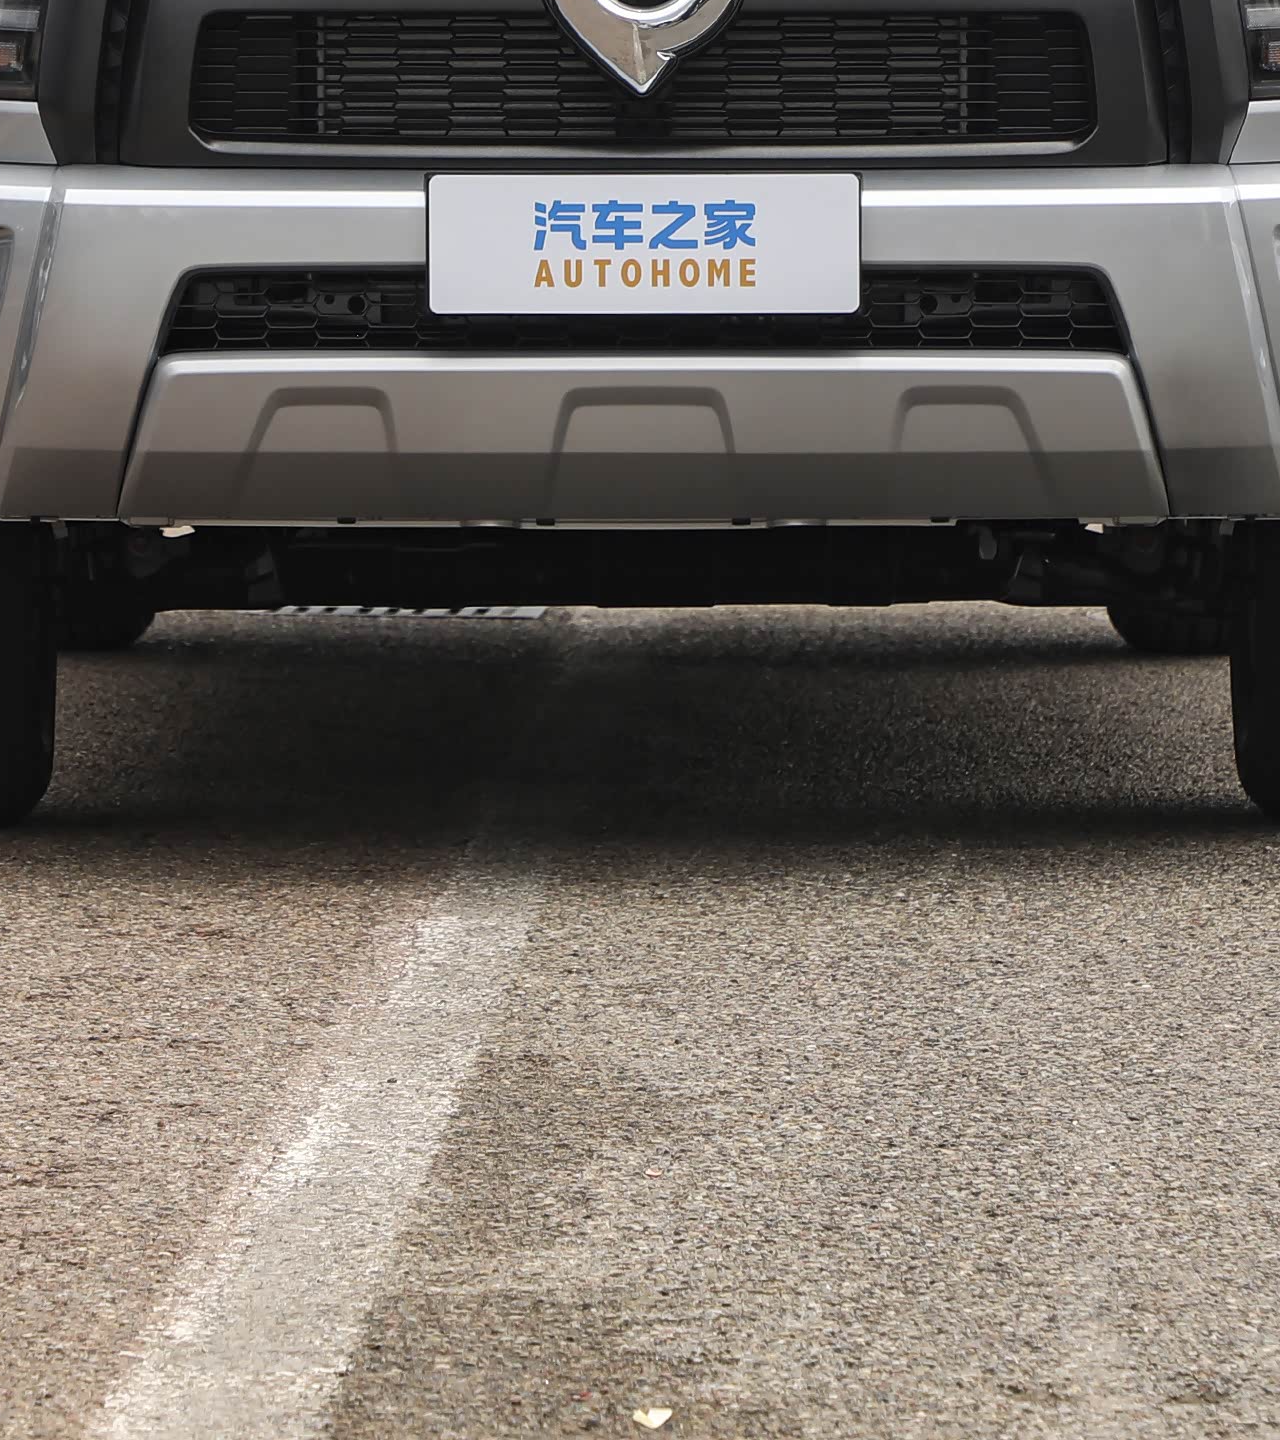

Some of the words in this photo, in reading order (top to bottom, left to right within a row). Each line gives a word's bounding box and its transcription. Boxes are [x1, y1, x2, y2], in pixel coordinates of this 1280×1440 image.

[533, 198, 757, 251] 汽车之家
[534, 258, 756, 288] AUTOHOME
